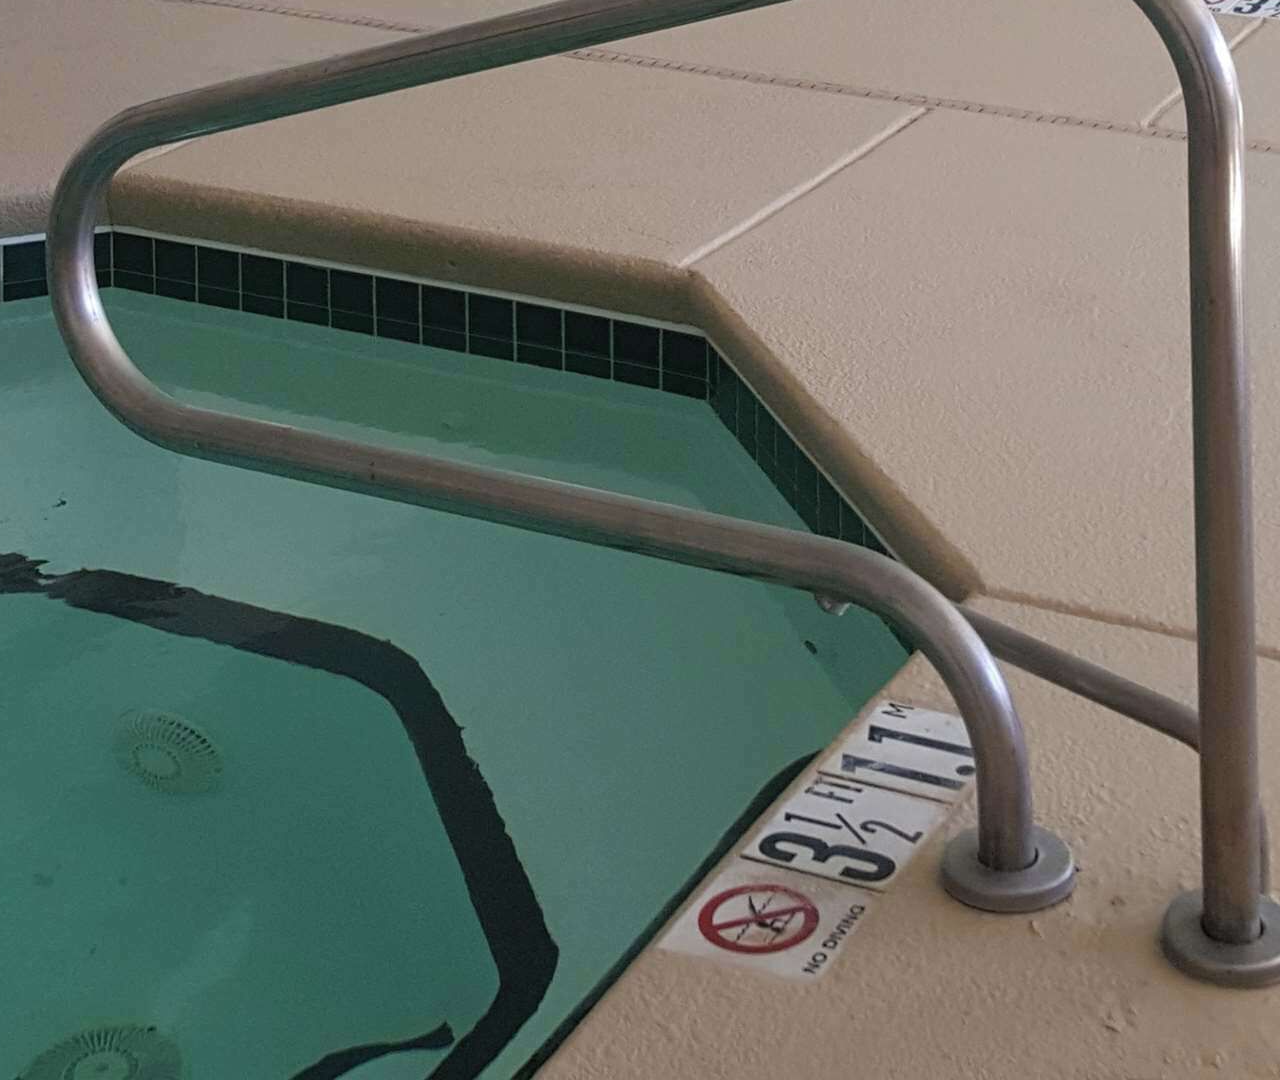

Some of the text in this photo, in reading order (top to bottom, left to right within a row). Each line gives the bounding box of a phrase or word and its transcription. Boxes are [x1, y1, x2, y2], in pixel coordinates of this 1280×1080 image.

[804, 777, 867, 805] FT
[881, 701, 915, 719] M
[802, 903, 866, 975] NO DIVING
